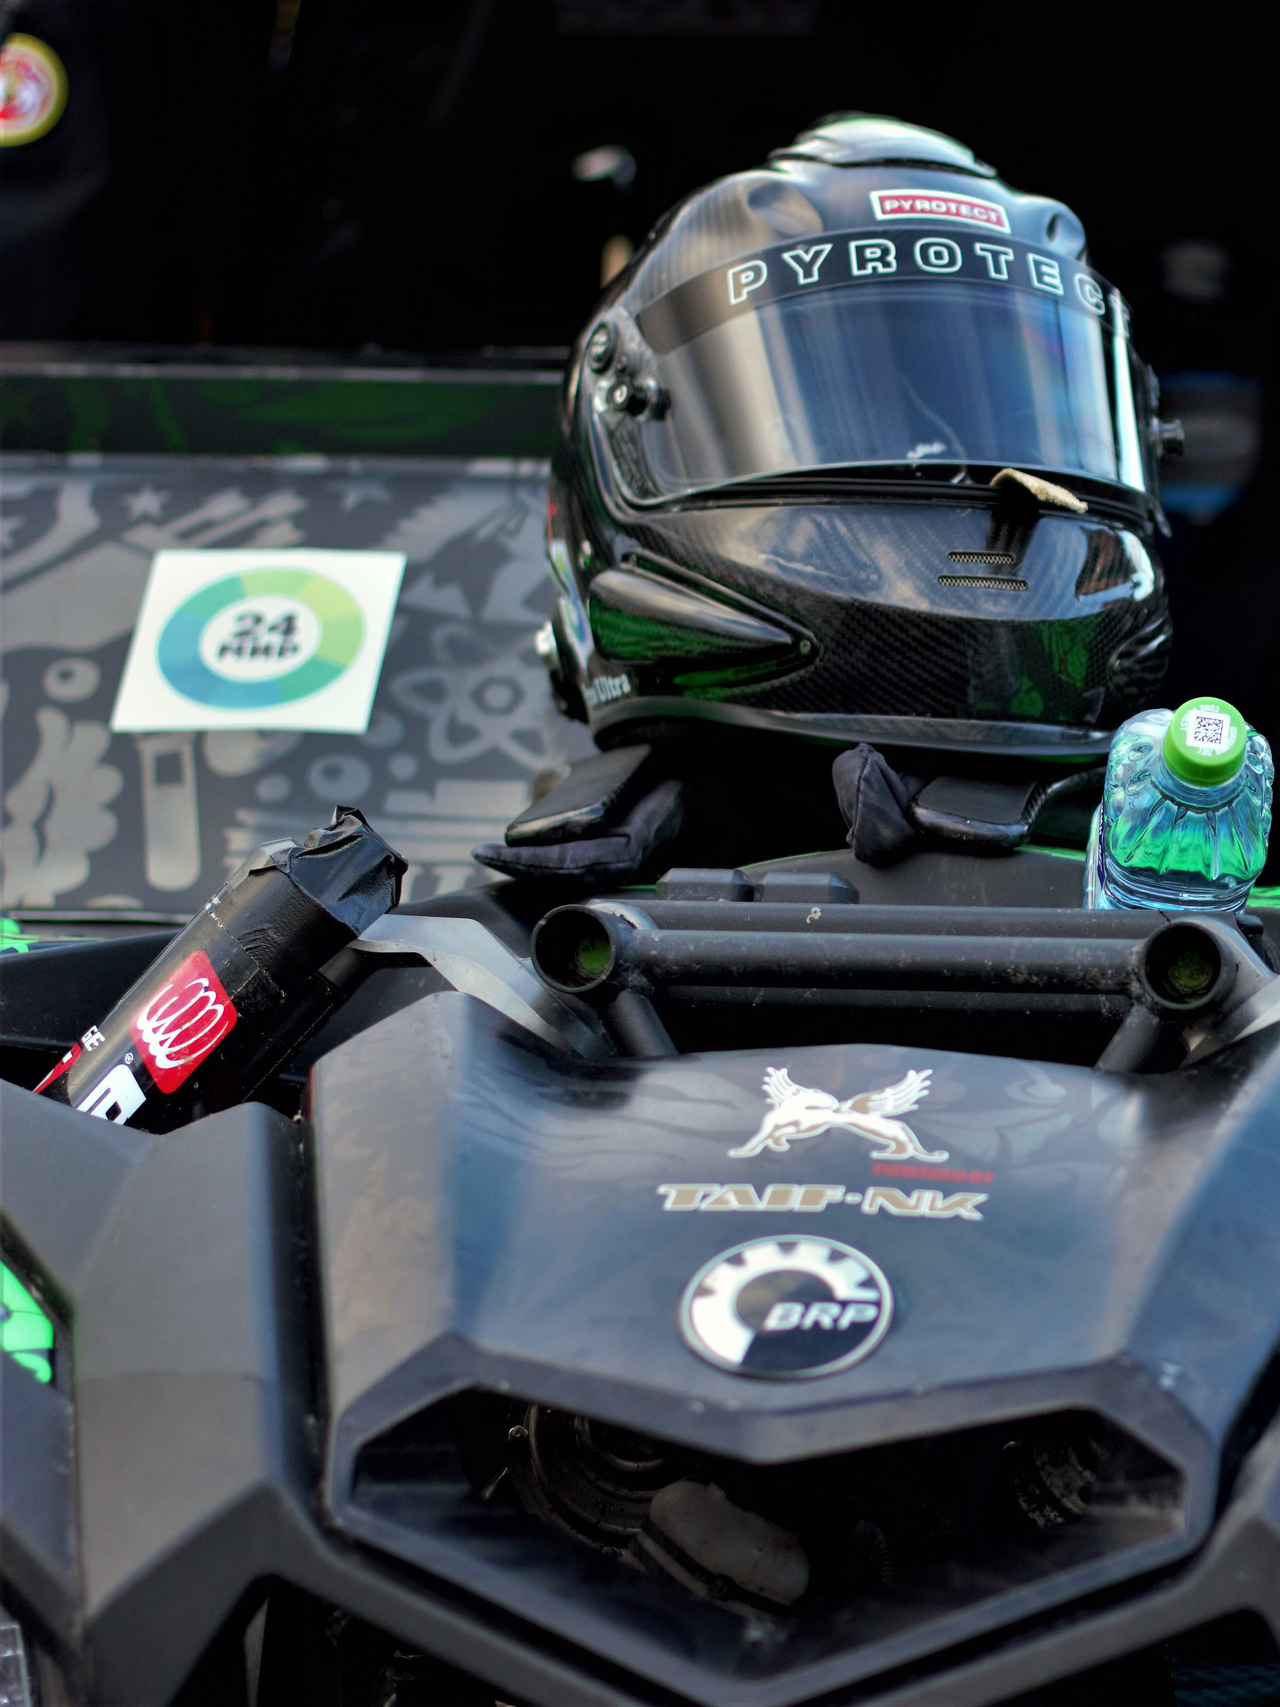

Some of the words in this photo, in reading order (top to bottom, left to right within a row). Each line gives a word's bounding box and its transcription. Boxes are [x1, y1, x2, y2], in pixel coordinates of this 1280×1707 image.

[883, 198, 1000, 222] PYROTECT
[232, 612, 296, 637] 24
[657, 1183, 990, 1221] TAIF-NK
[763, 1301, 880, 1331] BRP
